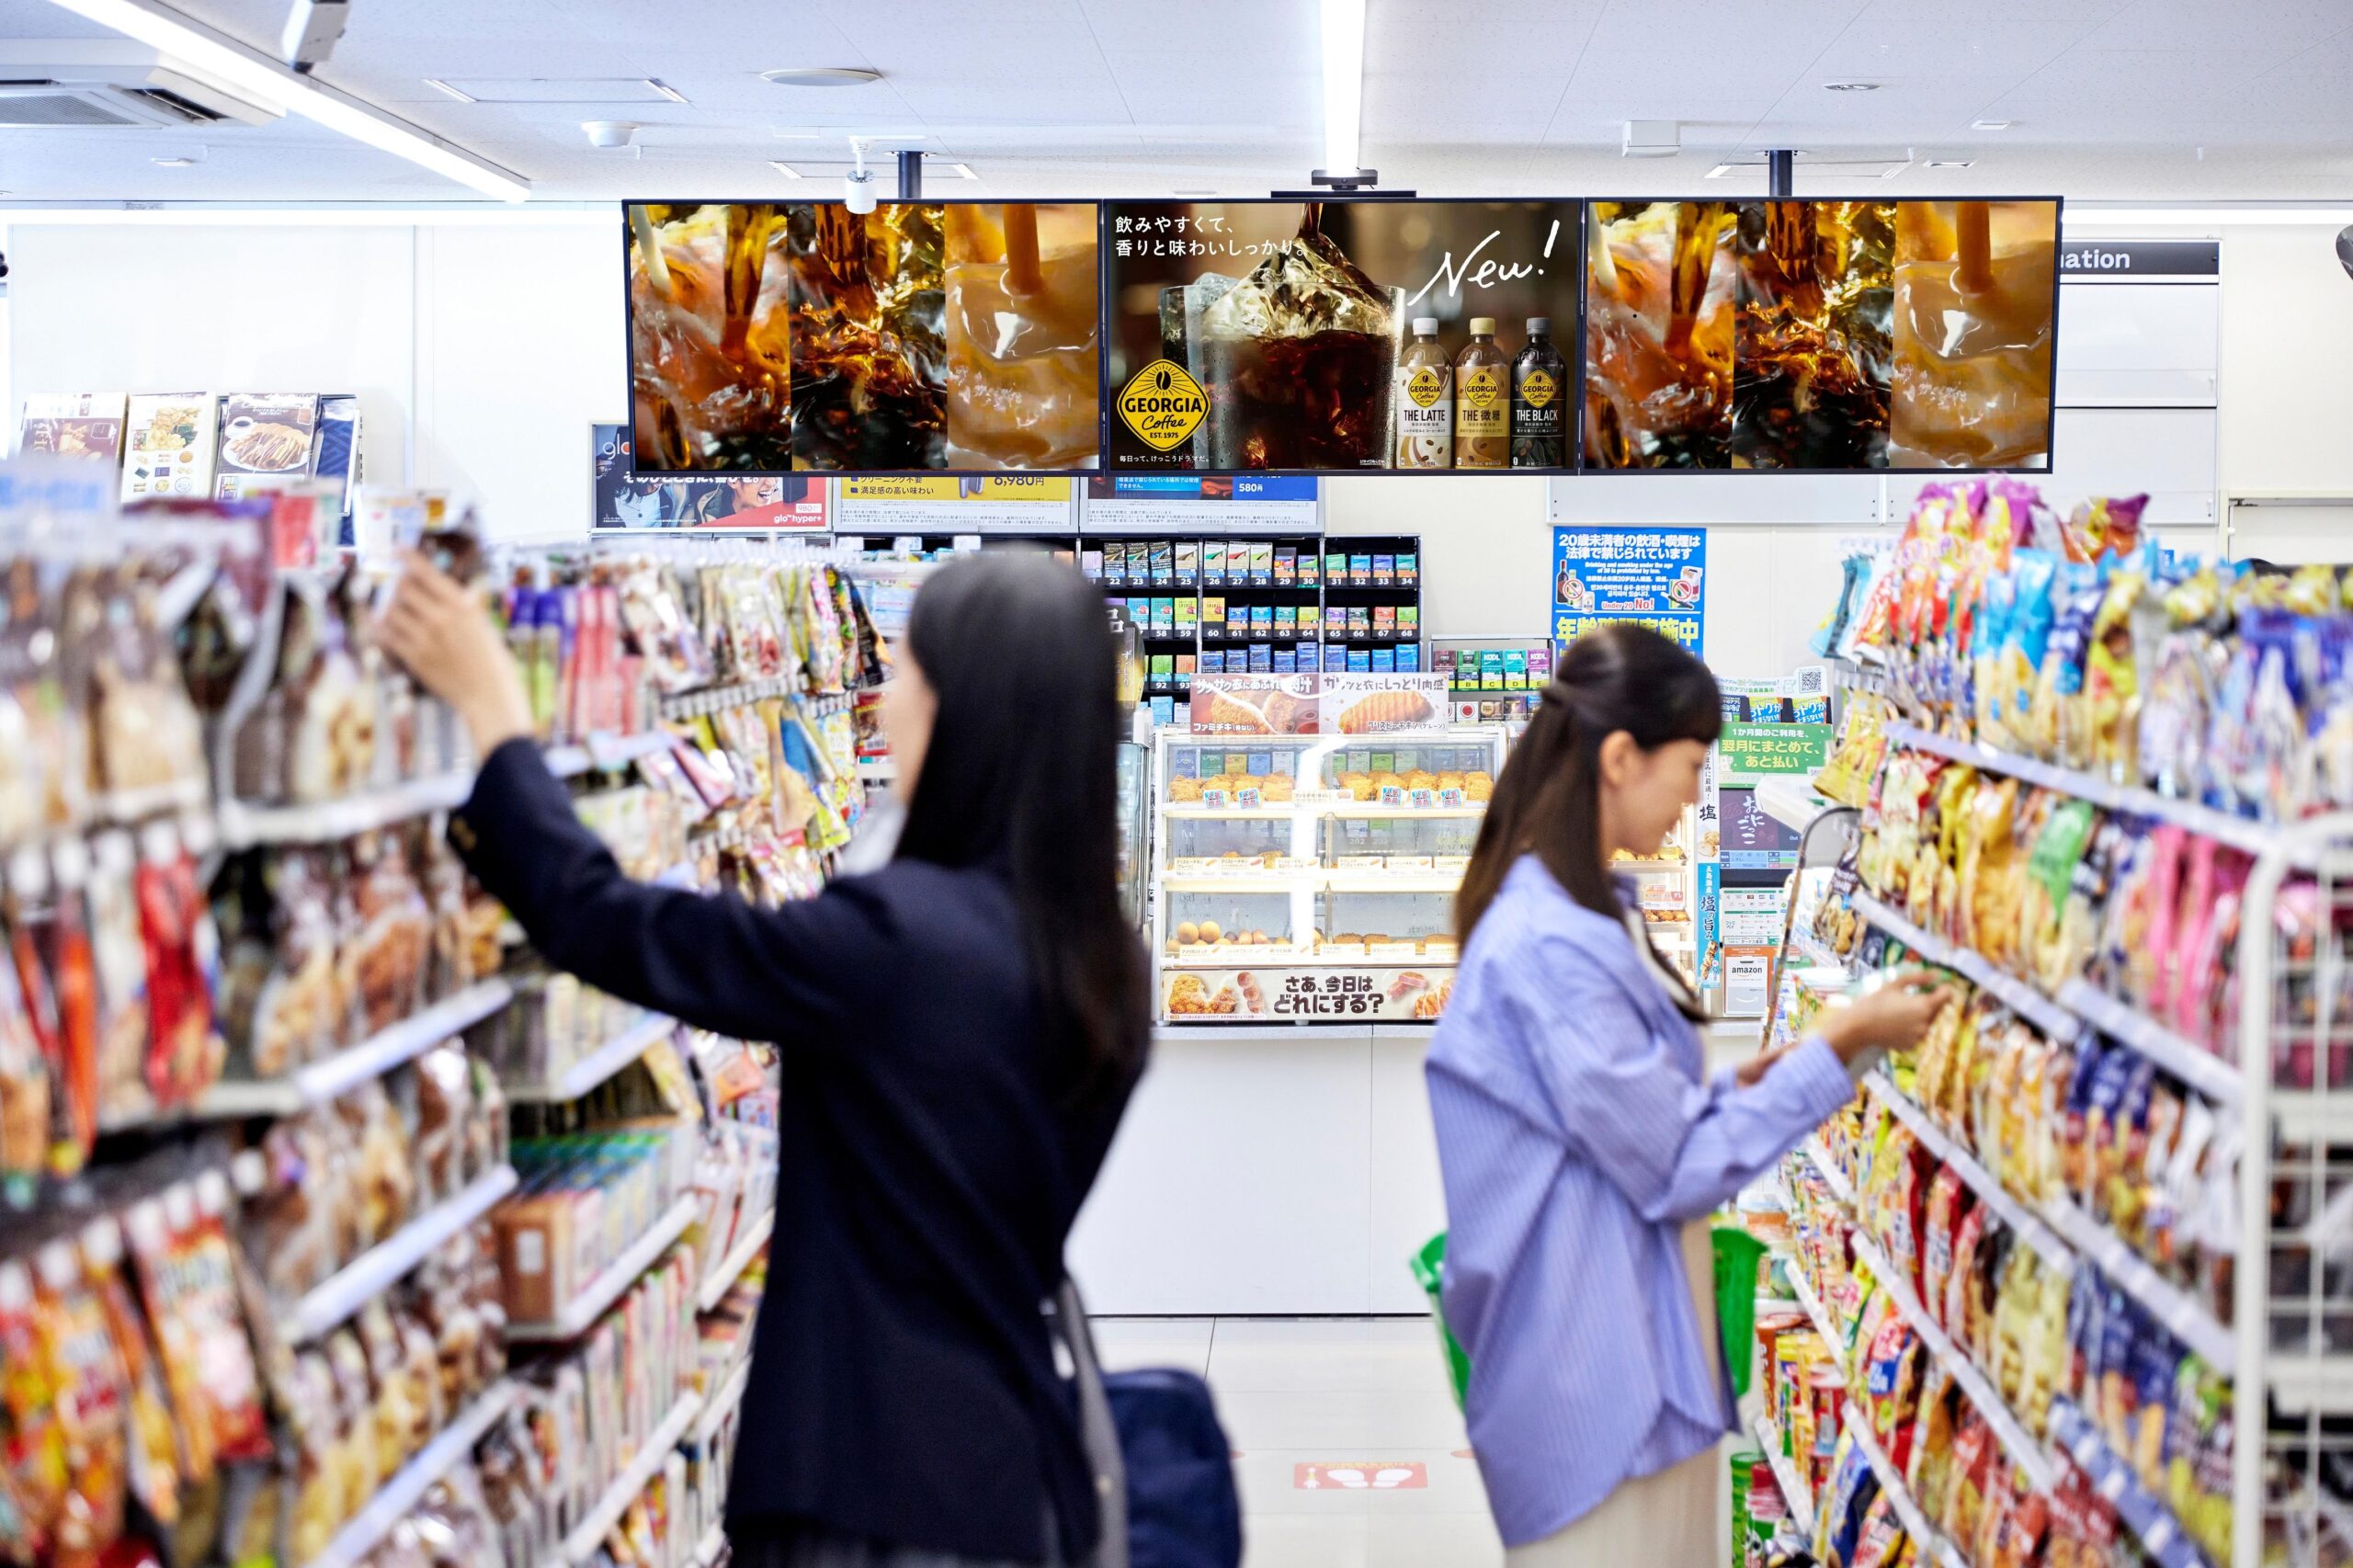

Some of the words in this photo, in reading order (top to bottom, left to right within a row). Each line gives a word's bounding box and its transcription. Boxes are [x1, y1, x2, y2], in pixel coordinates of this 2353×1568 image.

[1115, 216, 1233, 233] 飲みやすくて、
[1115, 239, 1303, 256] 香りと味わいしっかり。
[1407, 219, 1560, 306] New!
[2061, 249, 2130, 269] ation
[1124, 397, 1202, 413] GEORGIA
[1142, 415, 1187, 430] Coffee
[1404, 410, 1419, 421] THE
[1420, 410, 1446, 421] LATTE
[1462, 410, 1479, 421] THE
[1517, 410, 1531, 421] THE
[1532, 410, 1558, 421] BLACK
[860, 486, 934, 494] 満足感の高い味わい
[1565, 547, 1692, 560] 法律で禁じられています
[1635, 598, 1654, 609] No!
[1556, 617, 1699, 646] 年齢施中
[1196, 677, 1313, 694] サクサク衣にあふれ肉汁
[1733, 728, 1809, 738] 1か月間のご利用を、
[1722, 740, 1820, 754] 翌月にまとめて、
[1745, 756, 1799, 767] あと払い
[1699, 804, 1717, 821] 塩
[1285, 976, 1373, 993] さあ、今日は
[1274, 993, 1384, 1014] どれにする？
